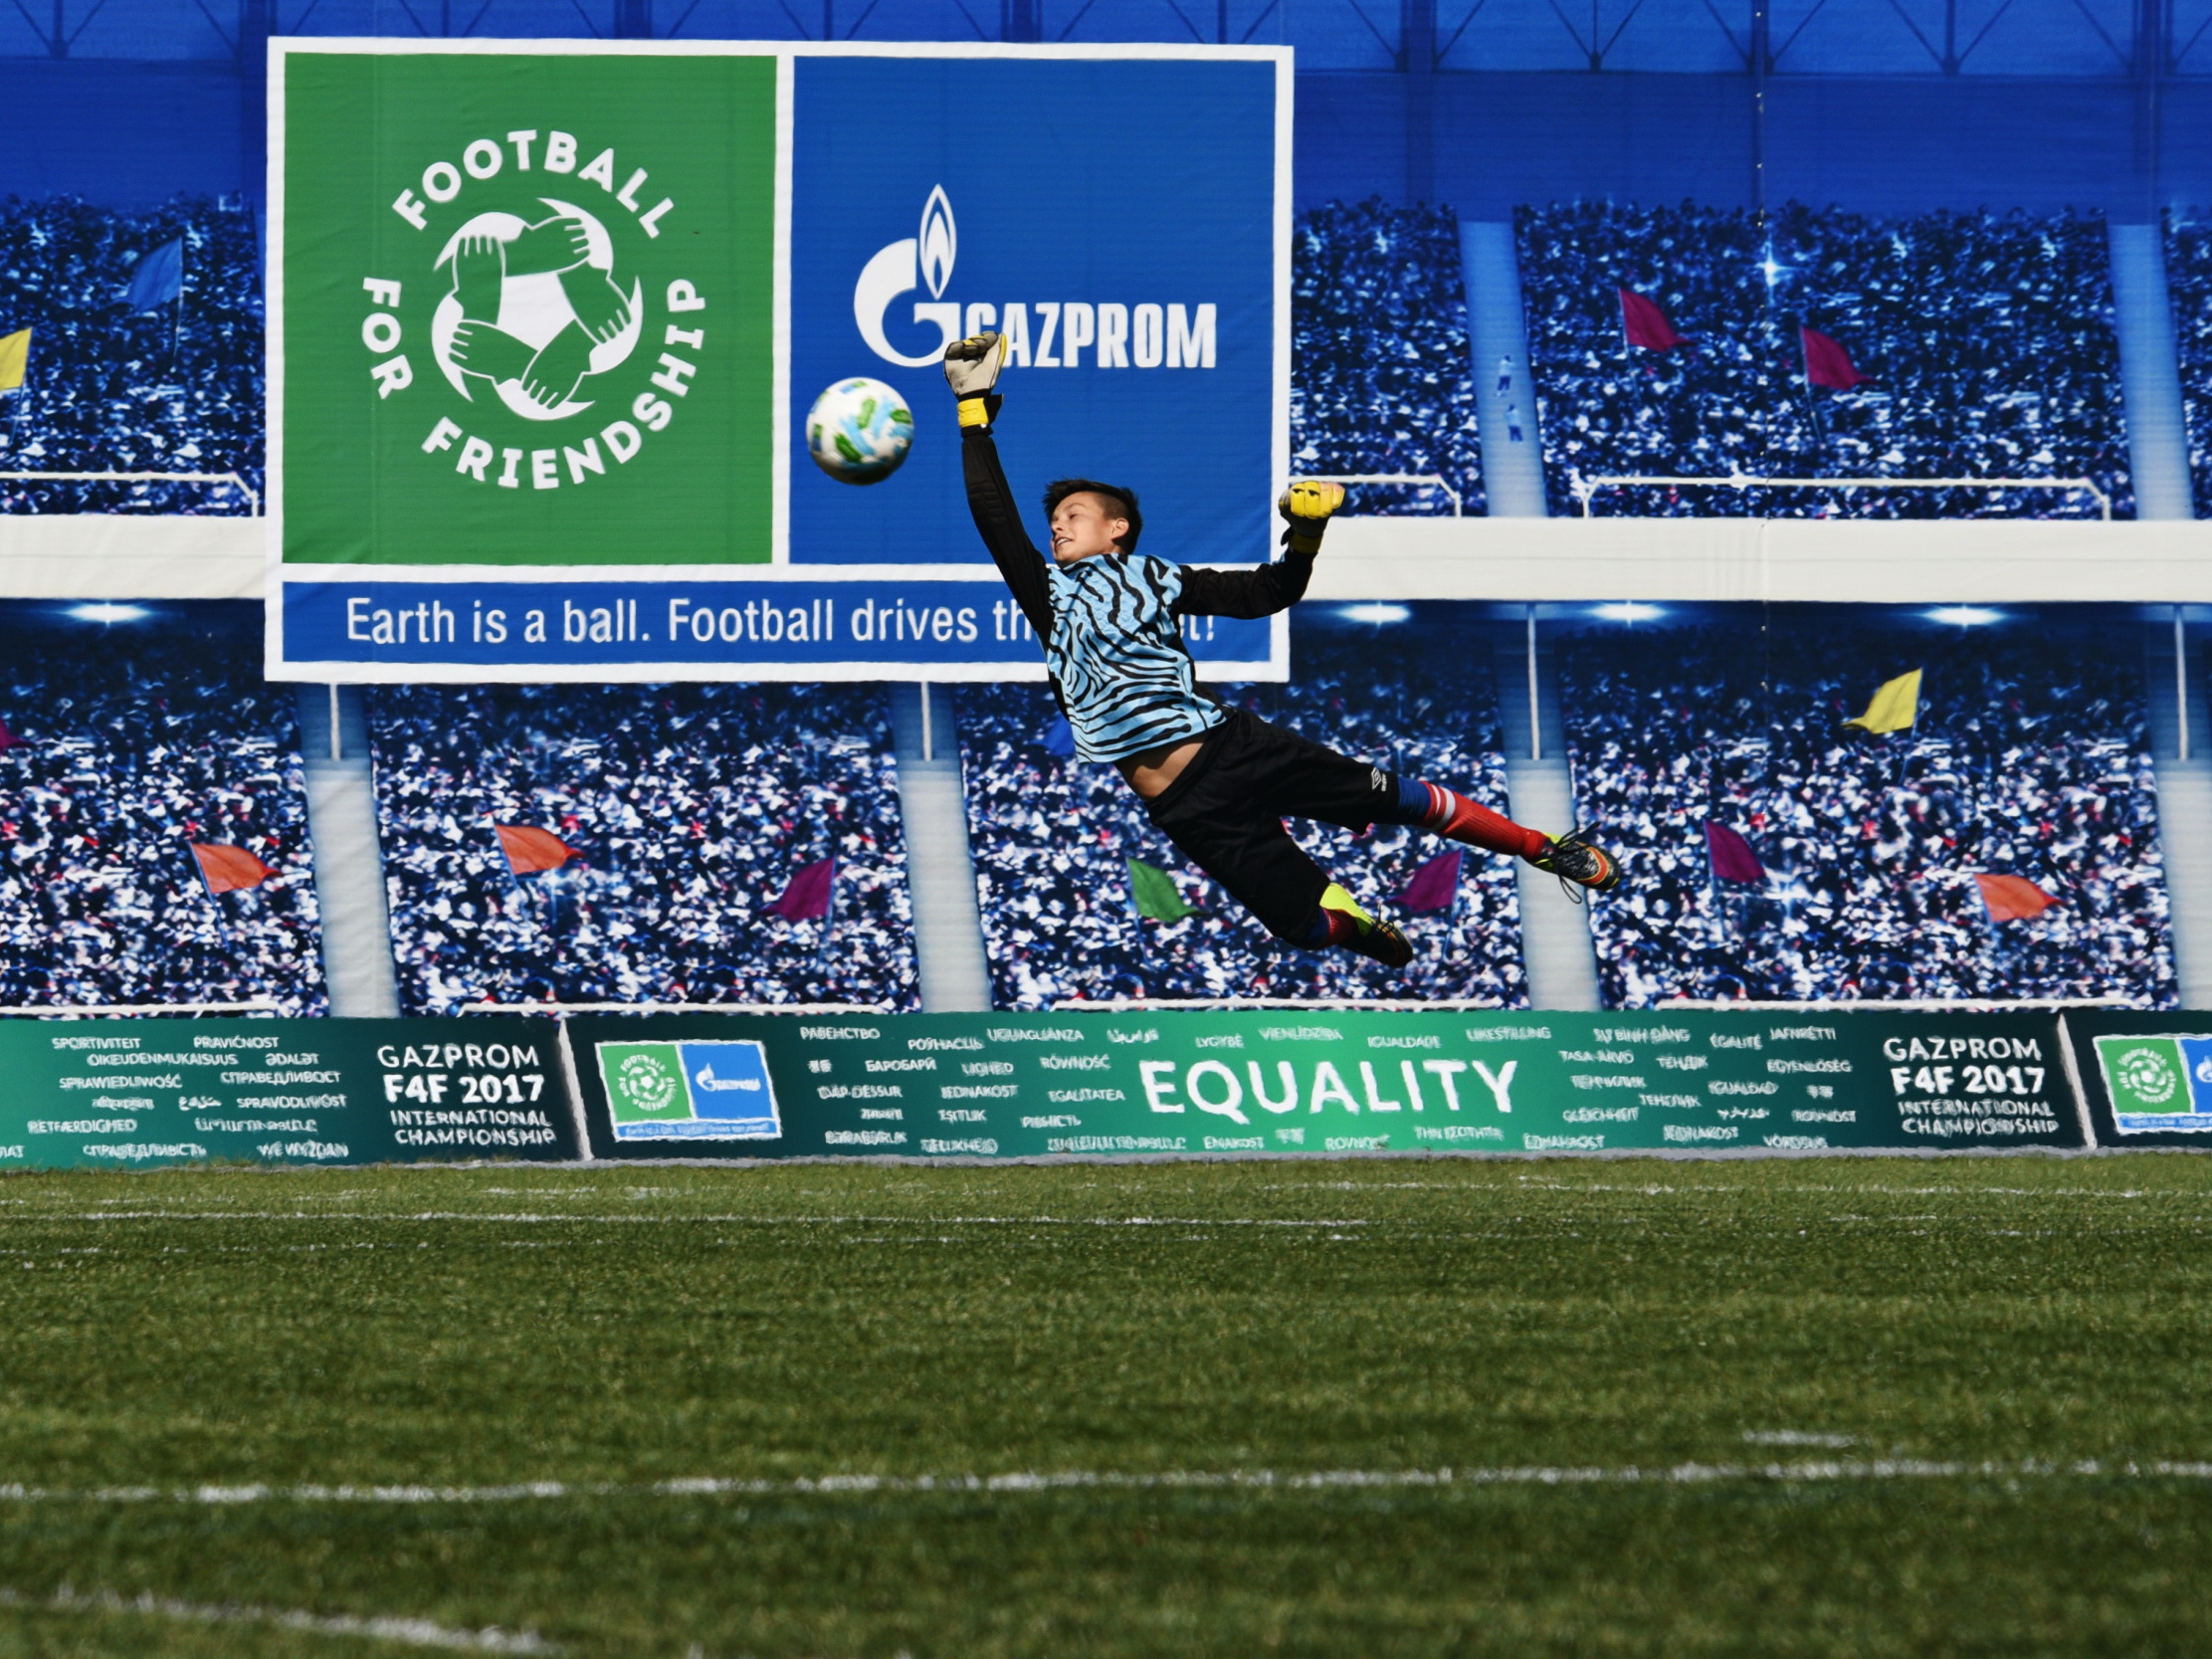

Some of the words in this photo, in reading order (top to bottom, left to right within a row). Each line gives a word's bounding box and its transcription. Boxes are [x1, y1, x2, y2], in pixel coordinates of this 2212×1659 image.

[391, 129, 675, 239] FOOTBALL
[362, 277, 414, 400] FOR
[421, 279, 706, 491] FRIENDSHIP
[347, 597, 455, 645] Earth
[473, 599, 507, 644] is
[523, 609, 546, 643] a
[563, 598, 651, 644] ball.
[669, 597, 834, 642] Football
[851, 598, 978, 642] drives
[992, 598, 1032, 641] th
[51, 1037, 141, 1050] SPORTIVITEIT
[376, 1043, 540, 1069] GAZPROM
[1883, 1036, 2043, 1062] GAZPROM
[87, 1052, 240, 1066] OIKEUDENMUKAISUUS
[382, 1074, 449, 1104] F4F
[458, 1074, 545, 1104] 2017
[1137, 1058, 1518, 1126] EQUALITY
[1890, 1066, 1955, 1096] F4F
[1961, 1065, 2046, 1094] 2017
[389, 1110, 552, 1127] INTERNATIONAL
[1898, 1100, 2056, 1117] INTERNATIONAL
[394, 1128, 556, 1145] CHAMPIONSHIP
[1902, 1118, 2059, 1137] CHAMPIONSHIP
